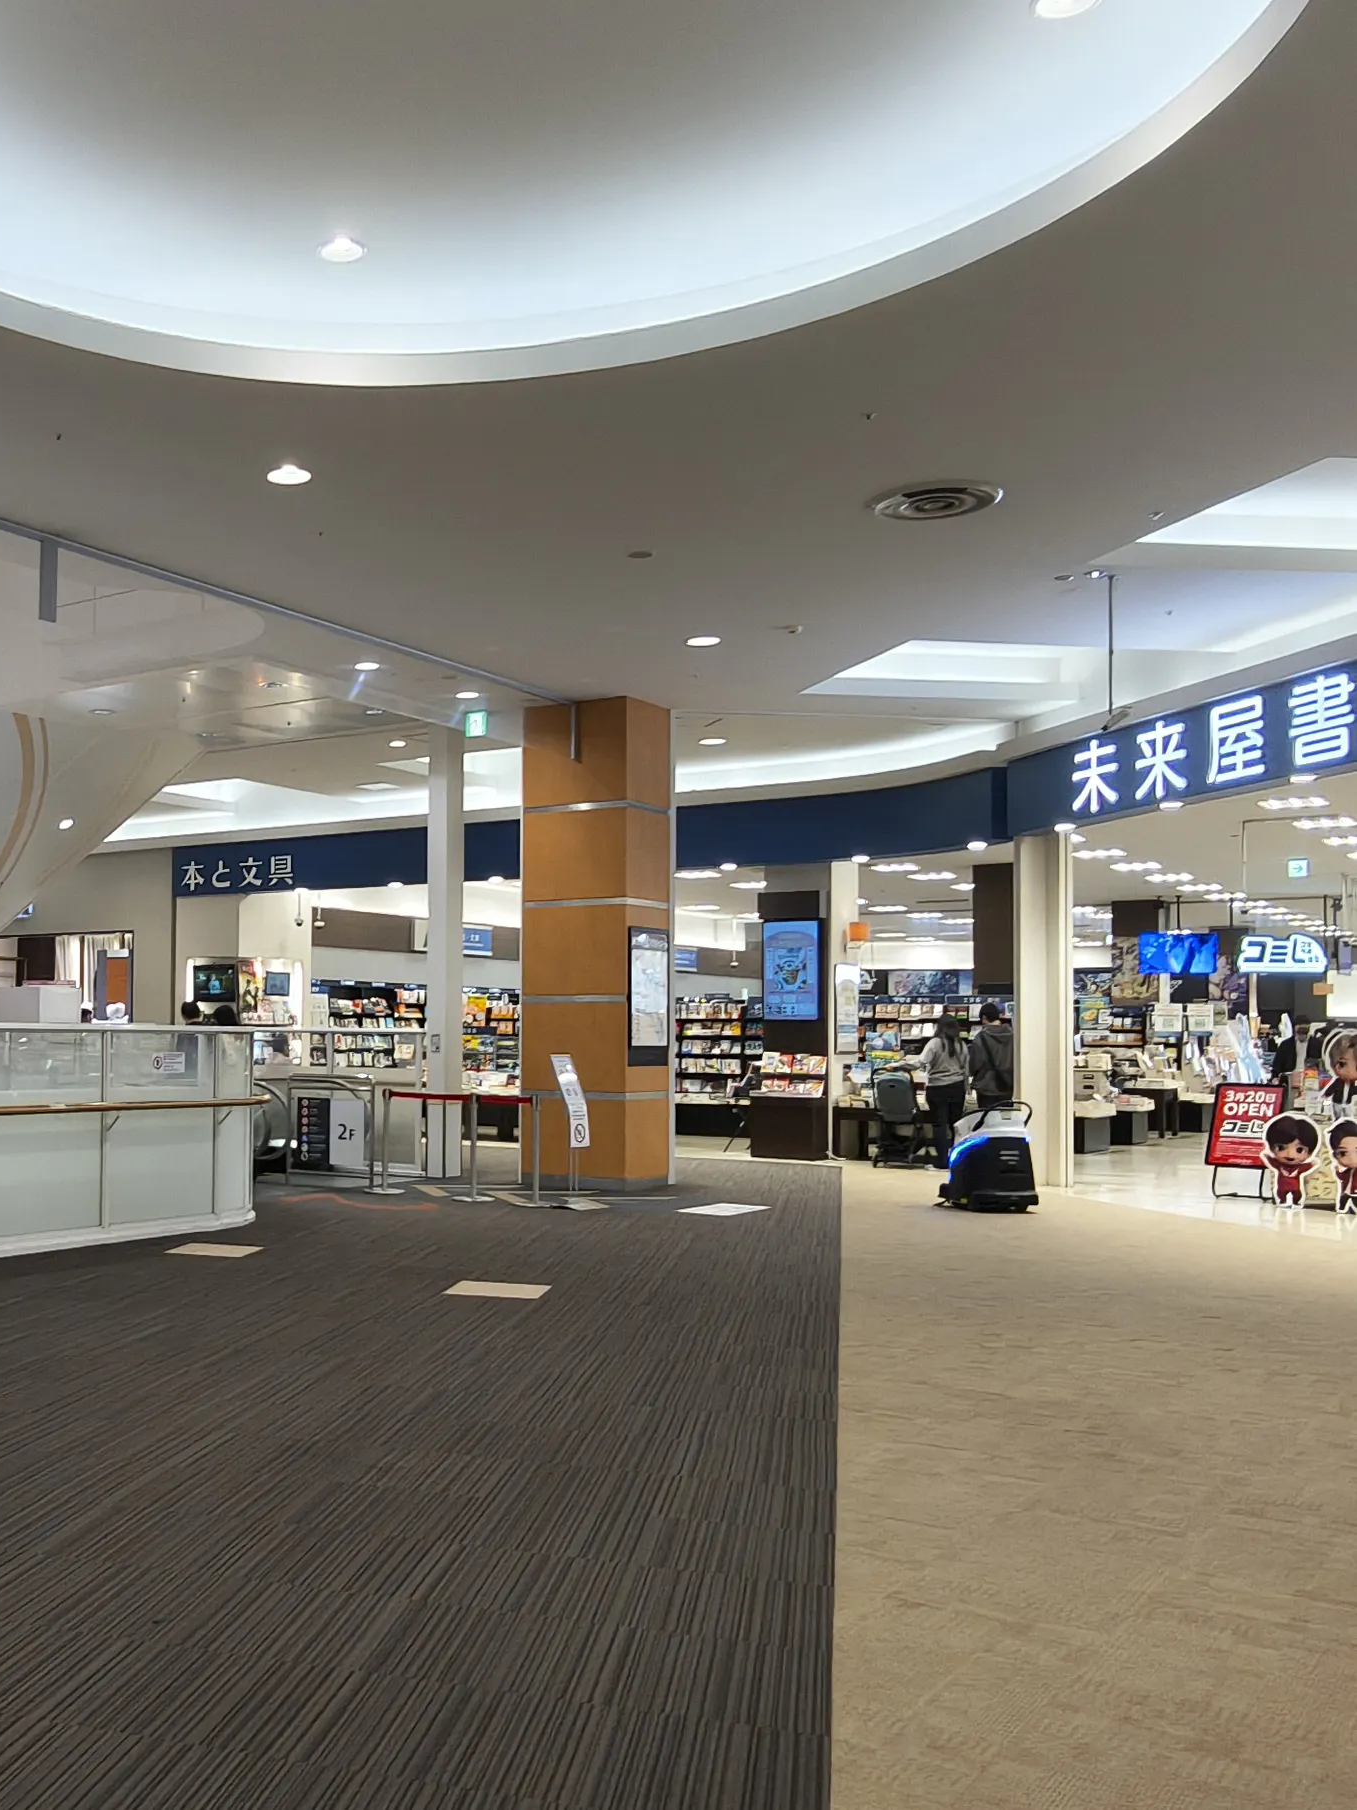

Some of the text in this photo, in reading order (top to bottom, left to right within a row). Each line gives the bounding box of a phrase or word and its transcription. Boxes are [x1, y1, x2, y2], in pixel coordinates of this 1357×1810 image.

[1071, 672, 1356, 815] 未来屋書
[180, 854, 294, 892] 本と文具
[1222, 1102, 1275, 1118] OPEN
[337, 1122, 357, 1141] 2F
